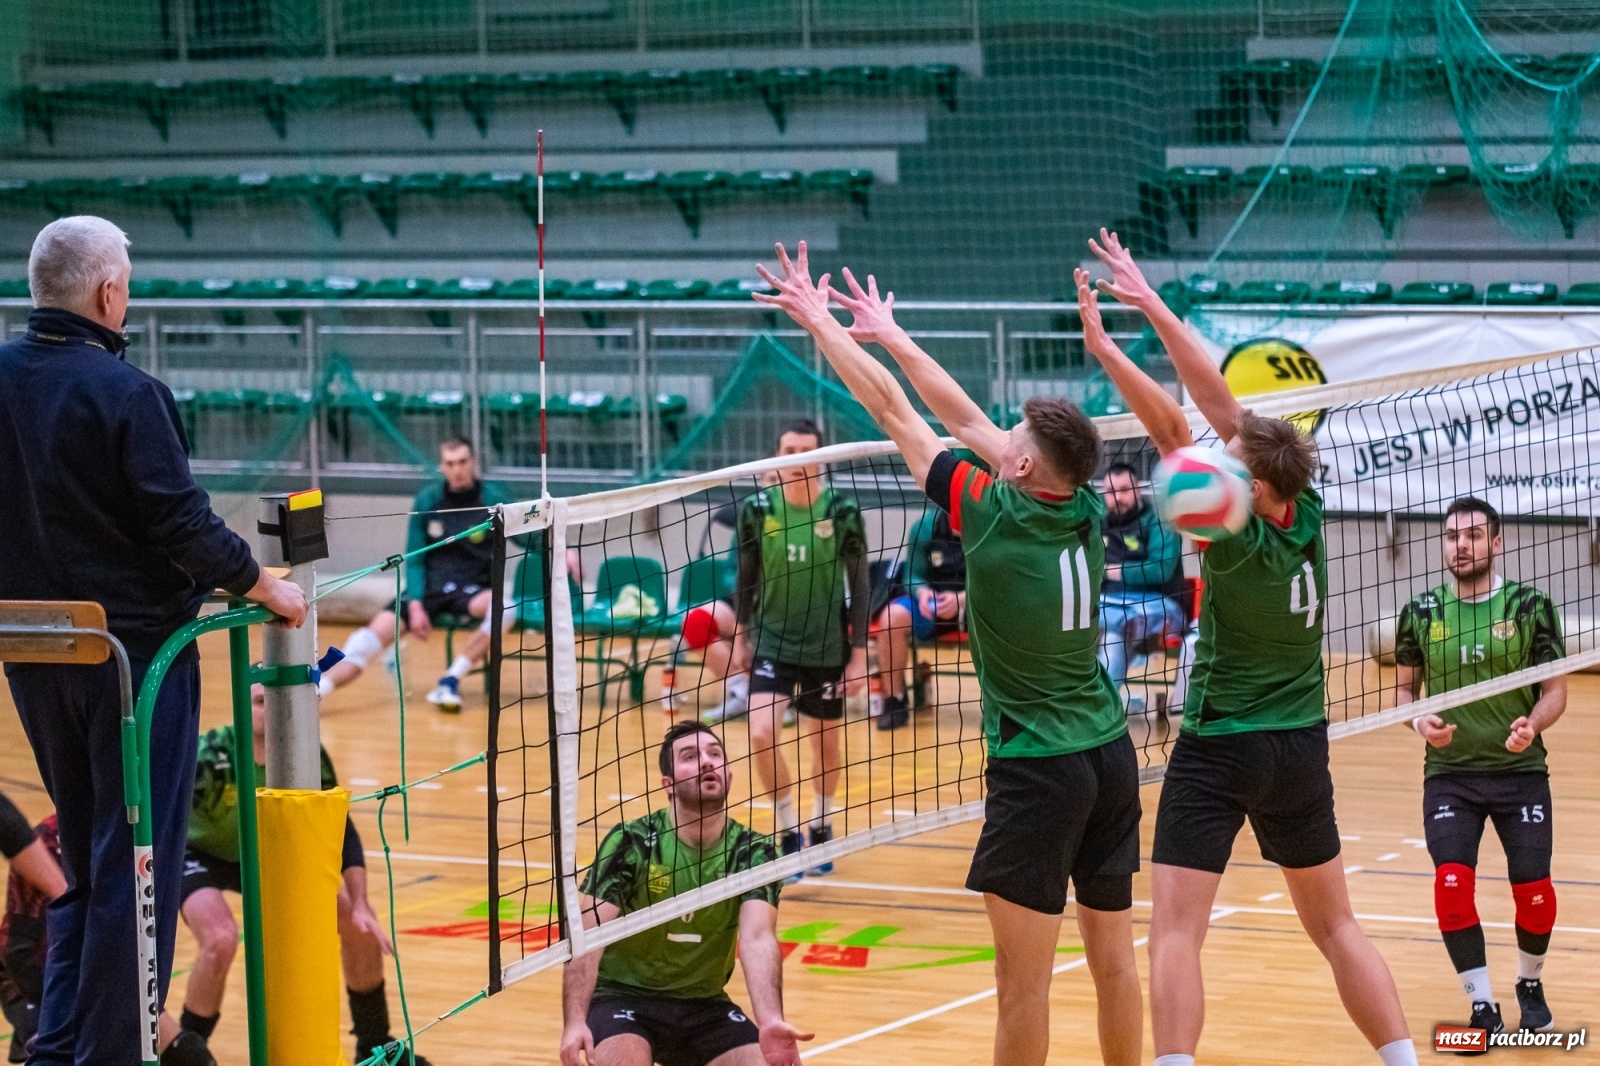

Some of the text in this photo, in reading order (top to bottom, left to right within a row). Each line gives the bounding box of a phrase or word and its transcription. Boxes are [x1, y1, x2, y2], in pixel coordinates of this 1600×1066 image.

[1354, 427, 1431, 475] JEST
[1441, 414, 1472, 447] W
[786, 543, 806, 563] 21
[1059, 545, 1091, 632] 11
[1290, 560, 1320, 629] 4
[1460, 644, 1485, 665] 15
[1521, 804, 1545, 823] 15
